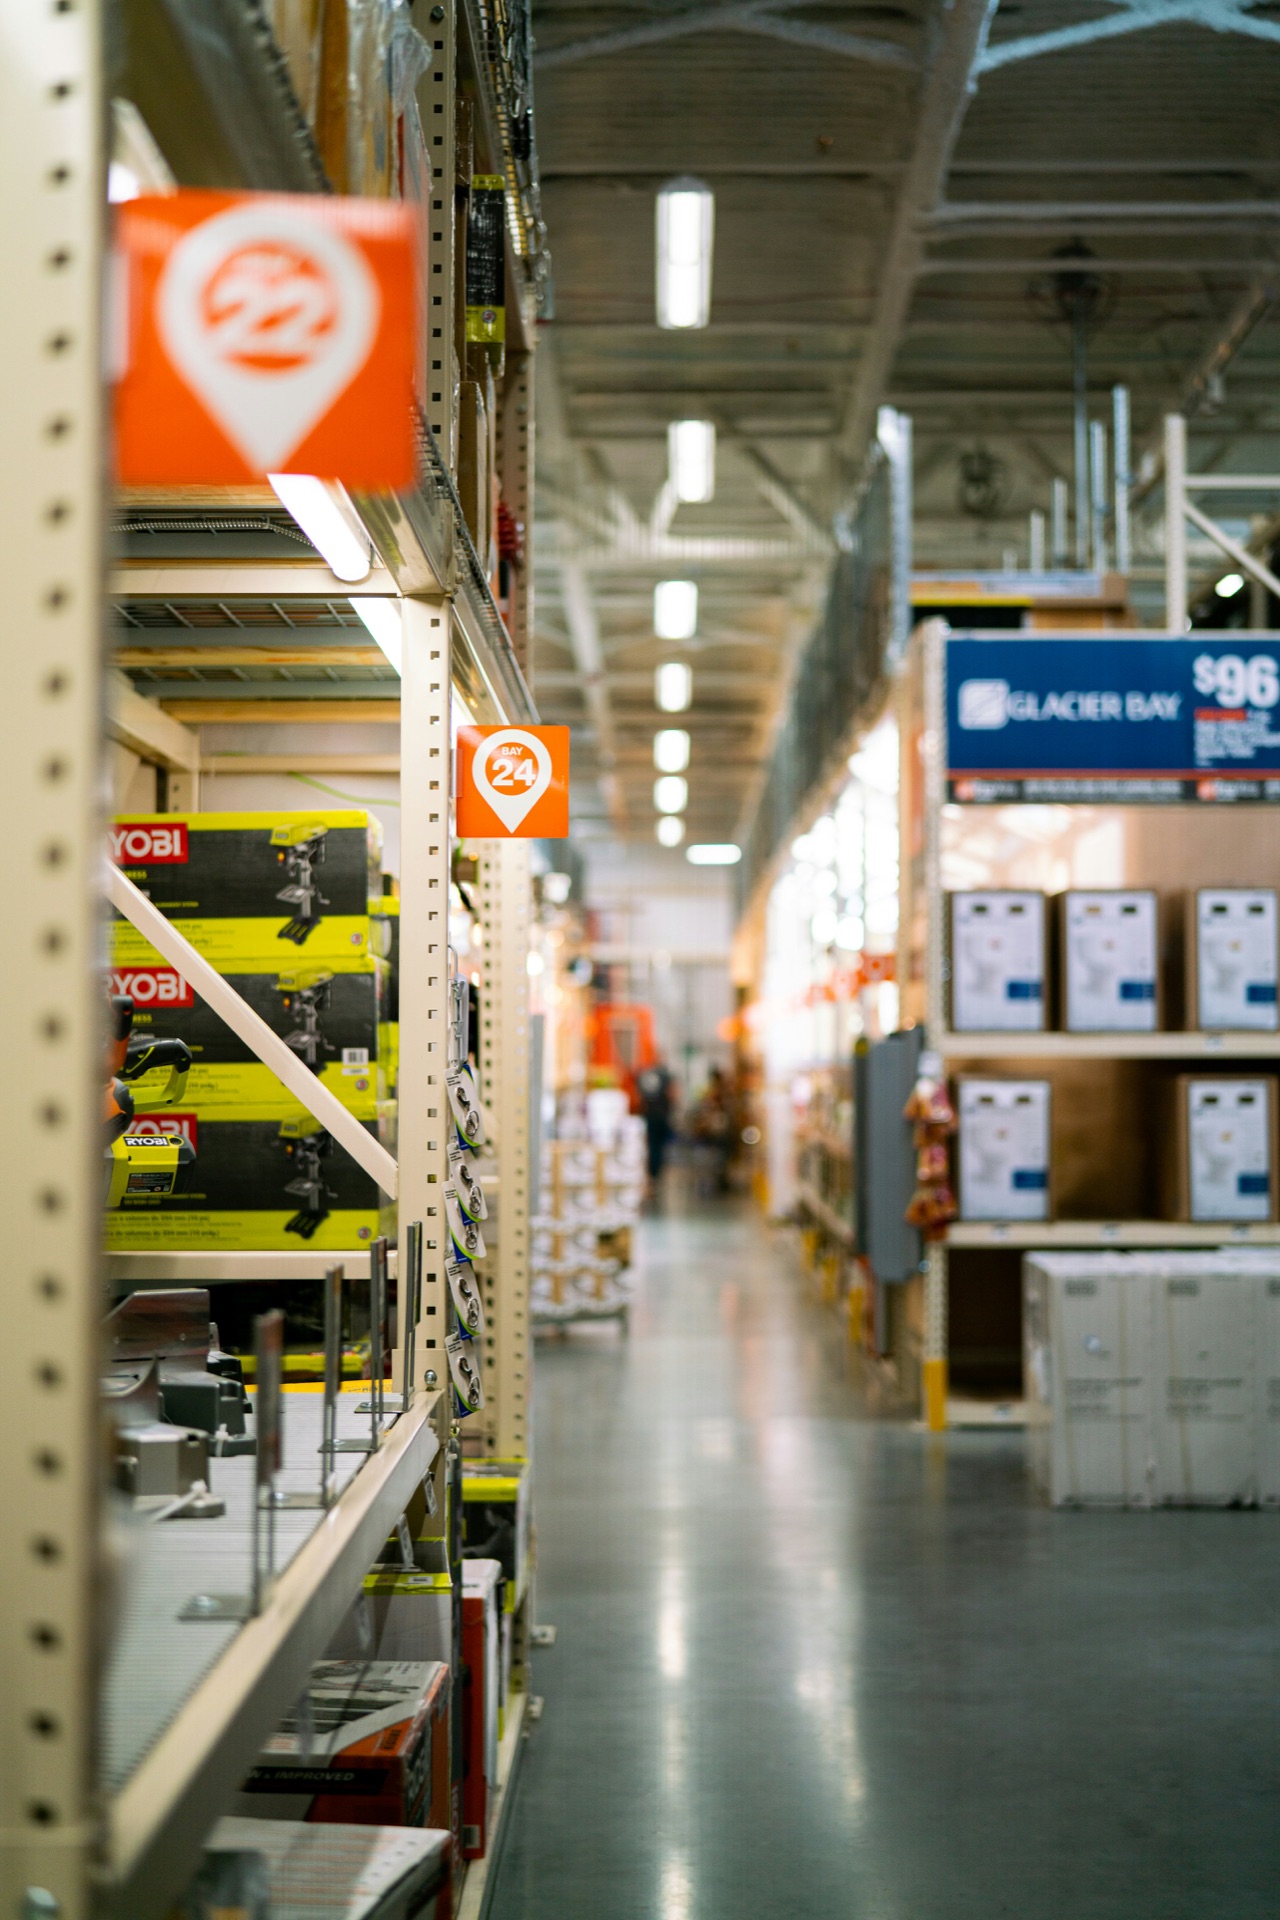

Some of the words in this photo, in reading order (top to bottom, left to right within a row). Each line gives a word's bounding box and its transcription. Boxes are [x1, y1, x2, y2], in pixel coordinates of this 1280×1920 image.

[209, 278, 331, 351] 22
[1193, 653, 1280, 708] $96
[1008, 690, 1123, 721] GLACIER
[1125, 690, 1183, 721] BAY
[502, 746, 523, 756] BAY
[492, 758, 536, 787] 24
[125, 1137, 168, 1146] RYOBI
[274, 1770, 356, 1781] IMPROVED
